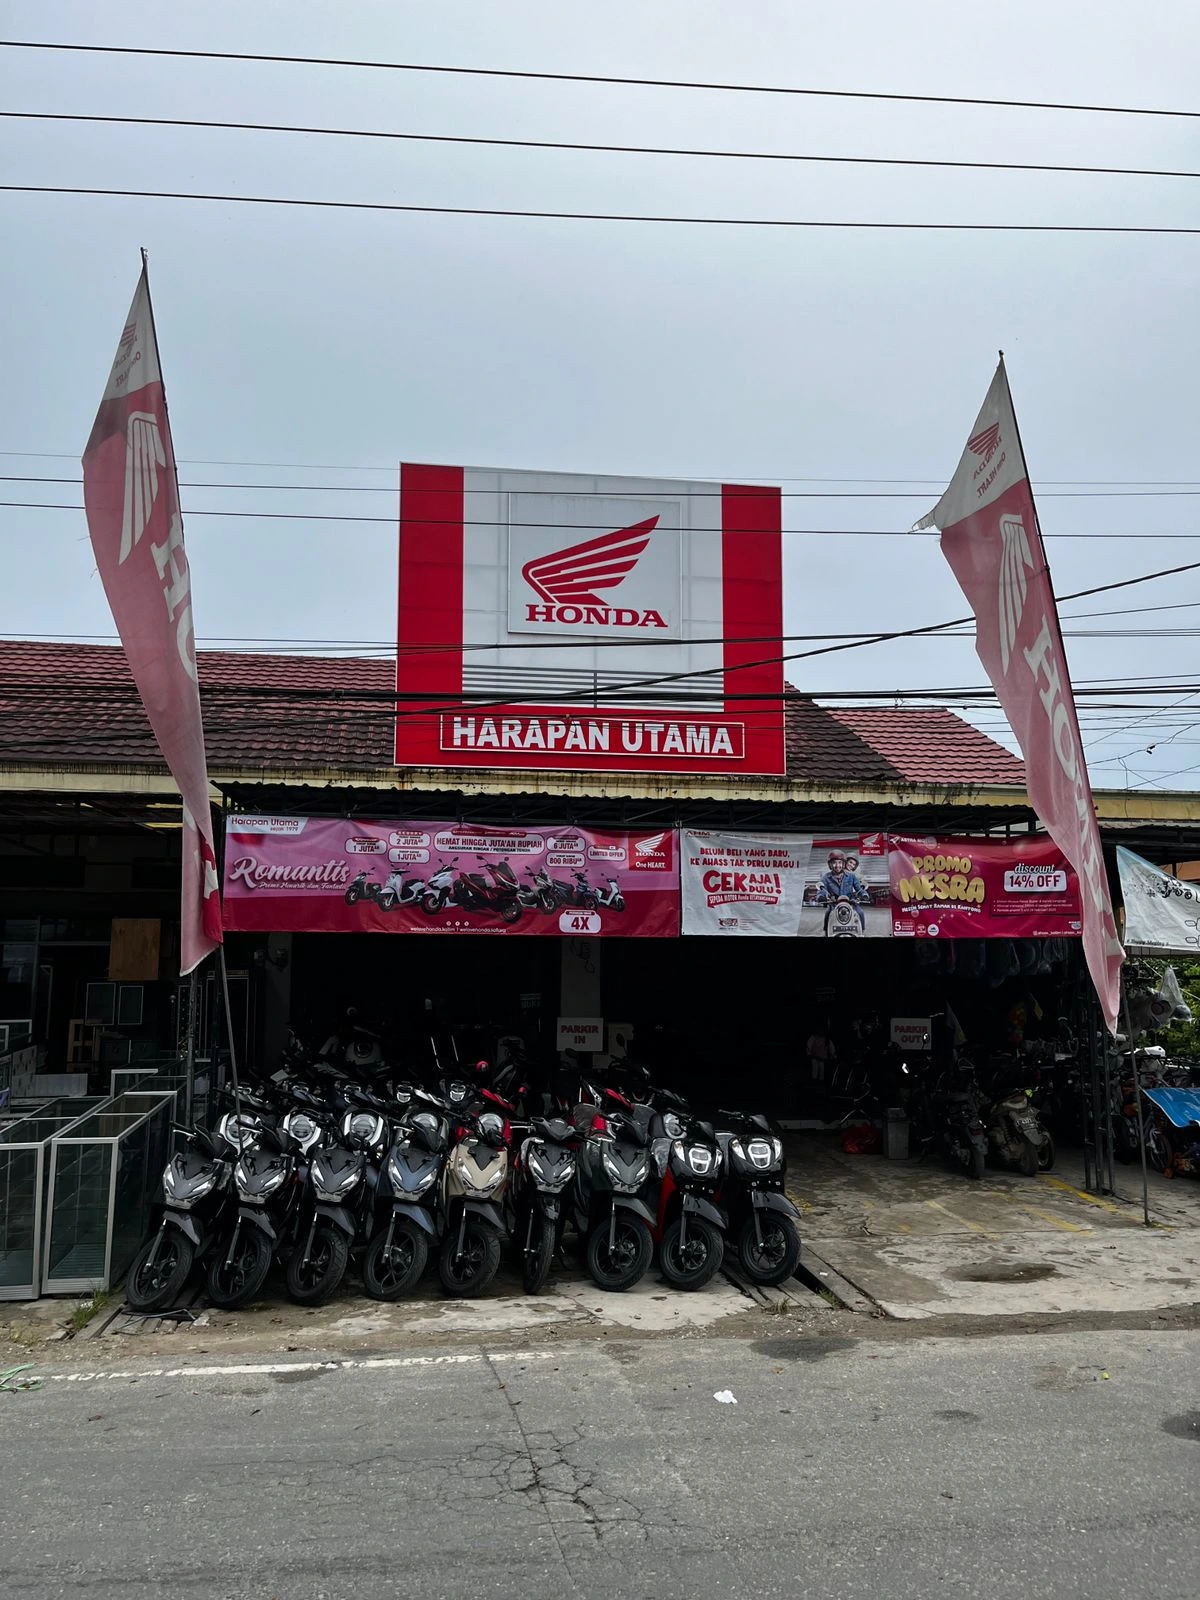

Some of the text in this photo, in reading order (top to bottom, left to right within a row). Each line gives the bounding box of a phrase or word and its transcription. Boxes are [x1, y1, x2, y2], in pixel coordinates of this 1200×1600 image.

[525, 604, 668, 627] HONDA
[453, 716, 734, 754] HARAPAN UTAMA
[231, 817, 299, 826] Harapan Utama
[462, 838, 487, 846] HINGGA
[518, 840, 542, 848] RUPIAH
[727, 848, 741, 856] BELI
[702, 858, 727, 866] AHASS
[773, 860, 794, 868] RAGU
[912, 854, 972, 874] PROMO
[229, 856, 350, 889] Romantis
[1014, 863, 1055, 874] discount
[703, 870, 747, 893] CEK
[749, 874, 772, 884] AJA
[1010, 875, 1060, 888] 14% OFF
[900, 873, 985, 903] MESRA
[571, 917, 589, 930] 4X
[894, 921, 901, 930] 5
[561, 1025, 598, 1033] PARKIR
[894, 1025, 928, 1033] PARKIR
[574, 1036, 586, 1044] IN
[901, 1035, 922, 1043] OUT
